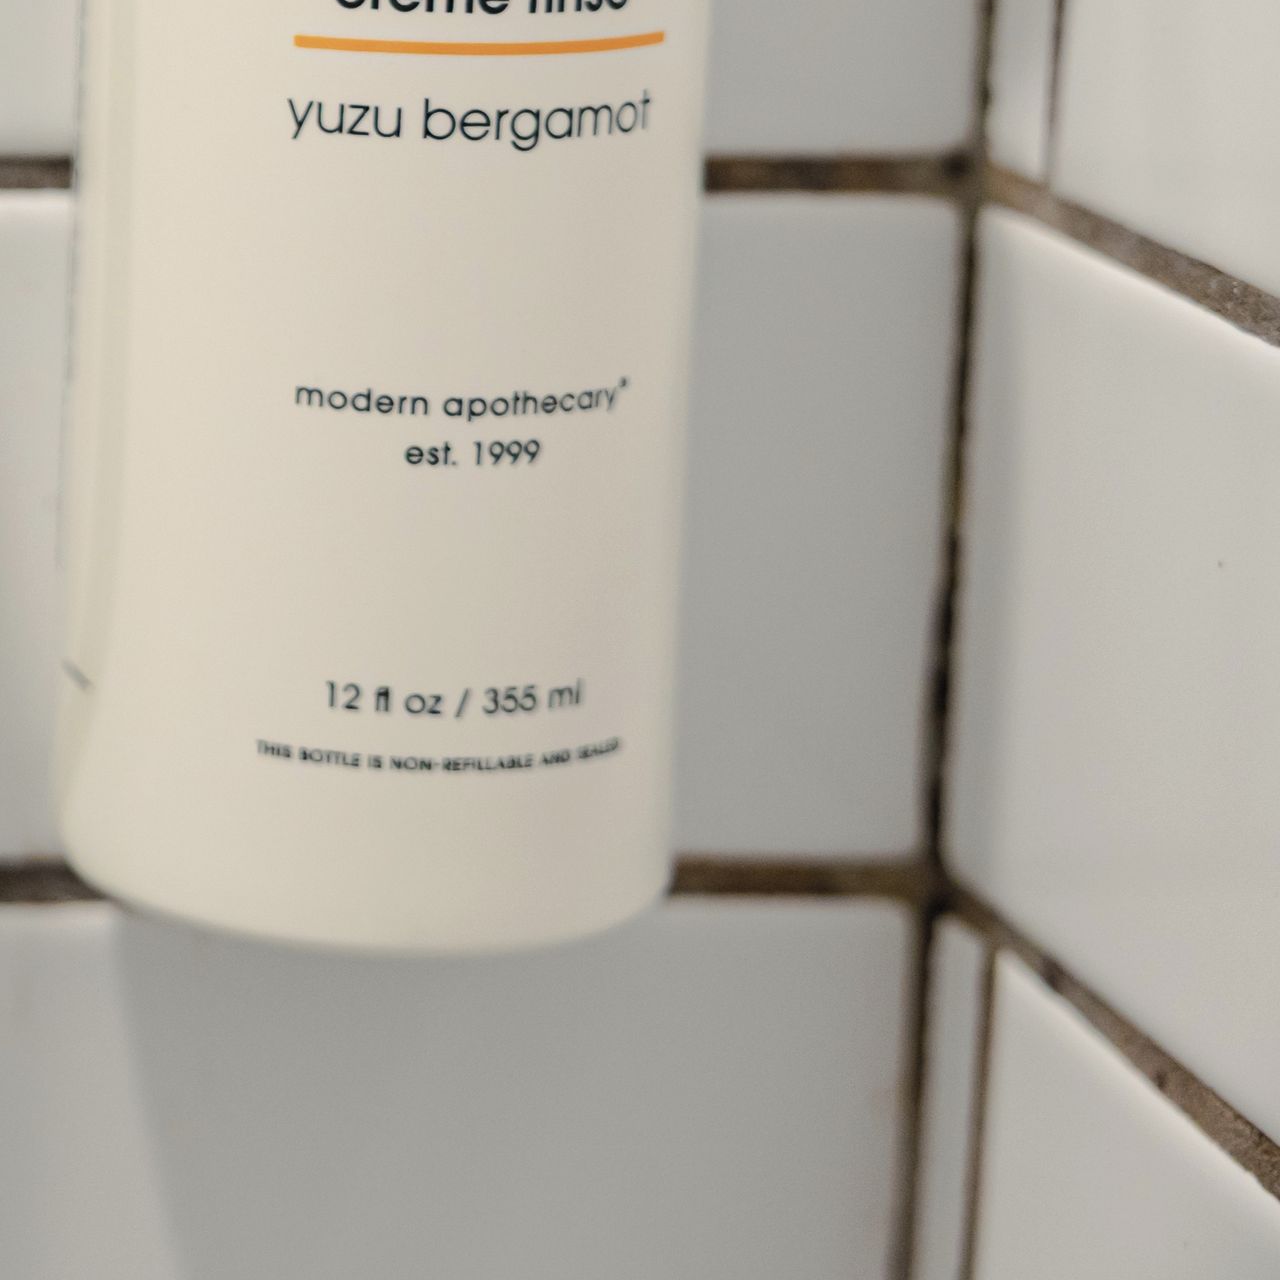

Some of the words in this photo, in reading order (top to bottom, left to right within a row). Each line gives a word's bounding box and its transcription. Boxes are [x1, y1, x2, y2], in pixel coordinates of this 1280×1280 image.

[287, 98, 403, 140] yuzu
[422, 90, 651, 152] bergamot
[295, 386, 430, 416] modern
[404, 441, 457, 466] est.
[474, 439, 542, 466] 1999
[326, 680, 362, 712] 12
[374, 686, 392, 713] fl
[404, 693, 444, 717] oz
[455, 688, 471, 718] /
[483, 685, 538, 716] 355
[548, 680, 582, 708] ml
[258, 740, 294, 760] THIS
[298, 747, 361, 769] BOTTLE
[367, 755, 384, 770] IS
[390, 754, 534, 773] NON-REFILLABLE
